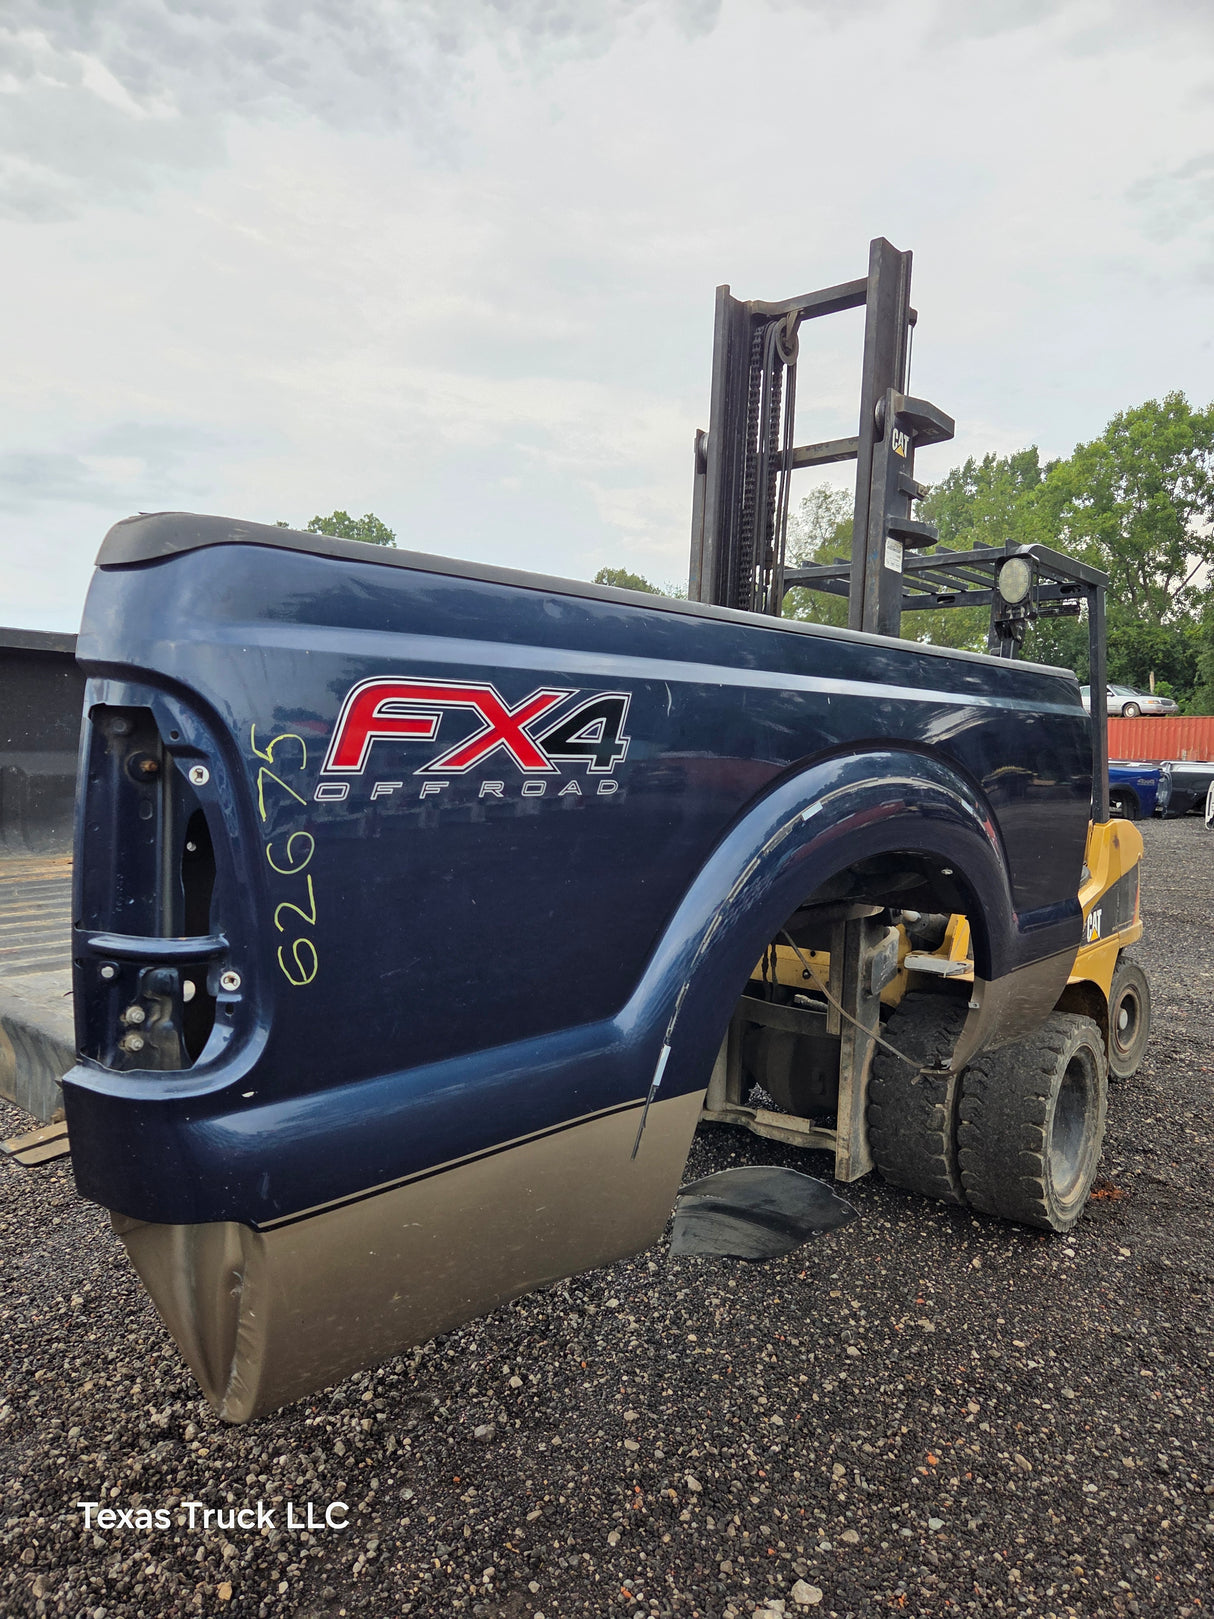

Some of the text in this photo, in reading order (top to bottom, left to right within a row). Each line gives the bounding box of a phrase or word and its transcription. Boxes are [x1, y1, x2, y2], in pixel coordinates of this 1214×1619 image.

[891, 427, 910, 458] CAT
[320, 675, 632, 775] FX4
[314, 779, 619, 801] OFF ROAD
[250, 723, 318, 986] 62675
[1086, 909, 1102, 942] CAT
